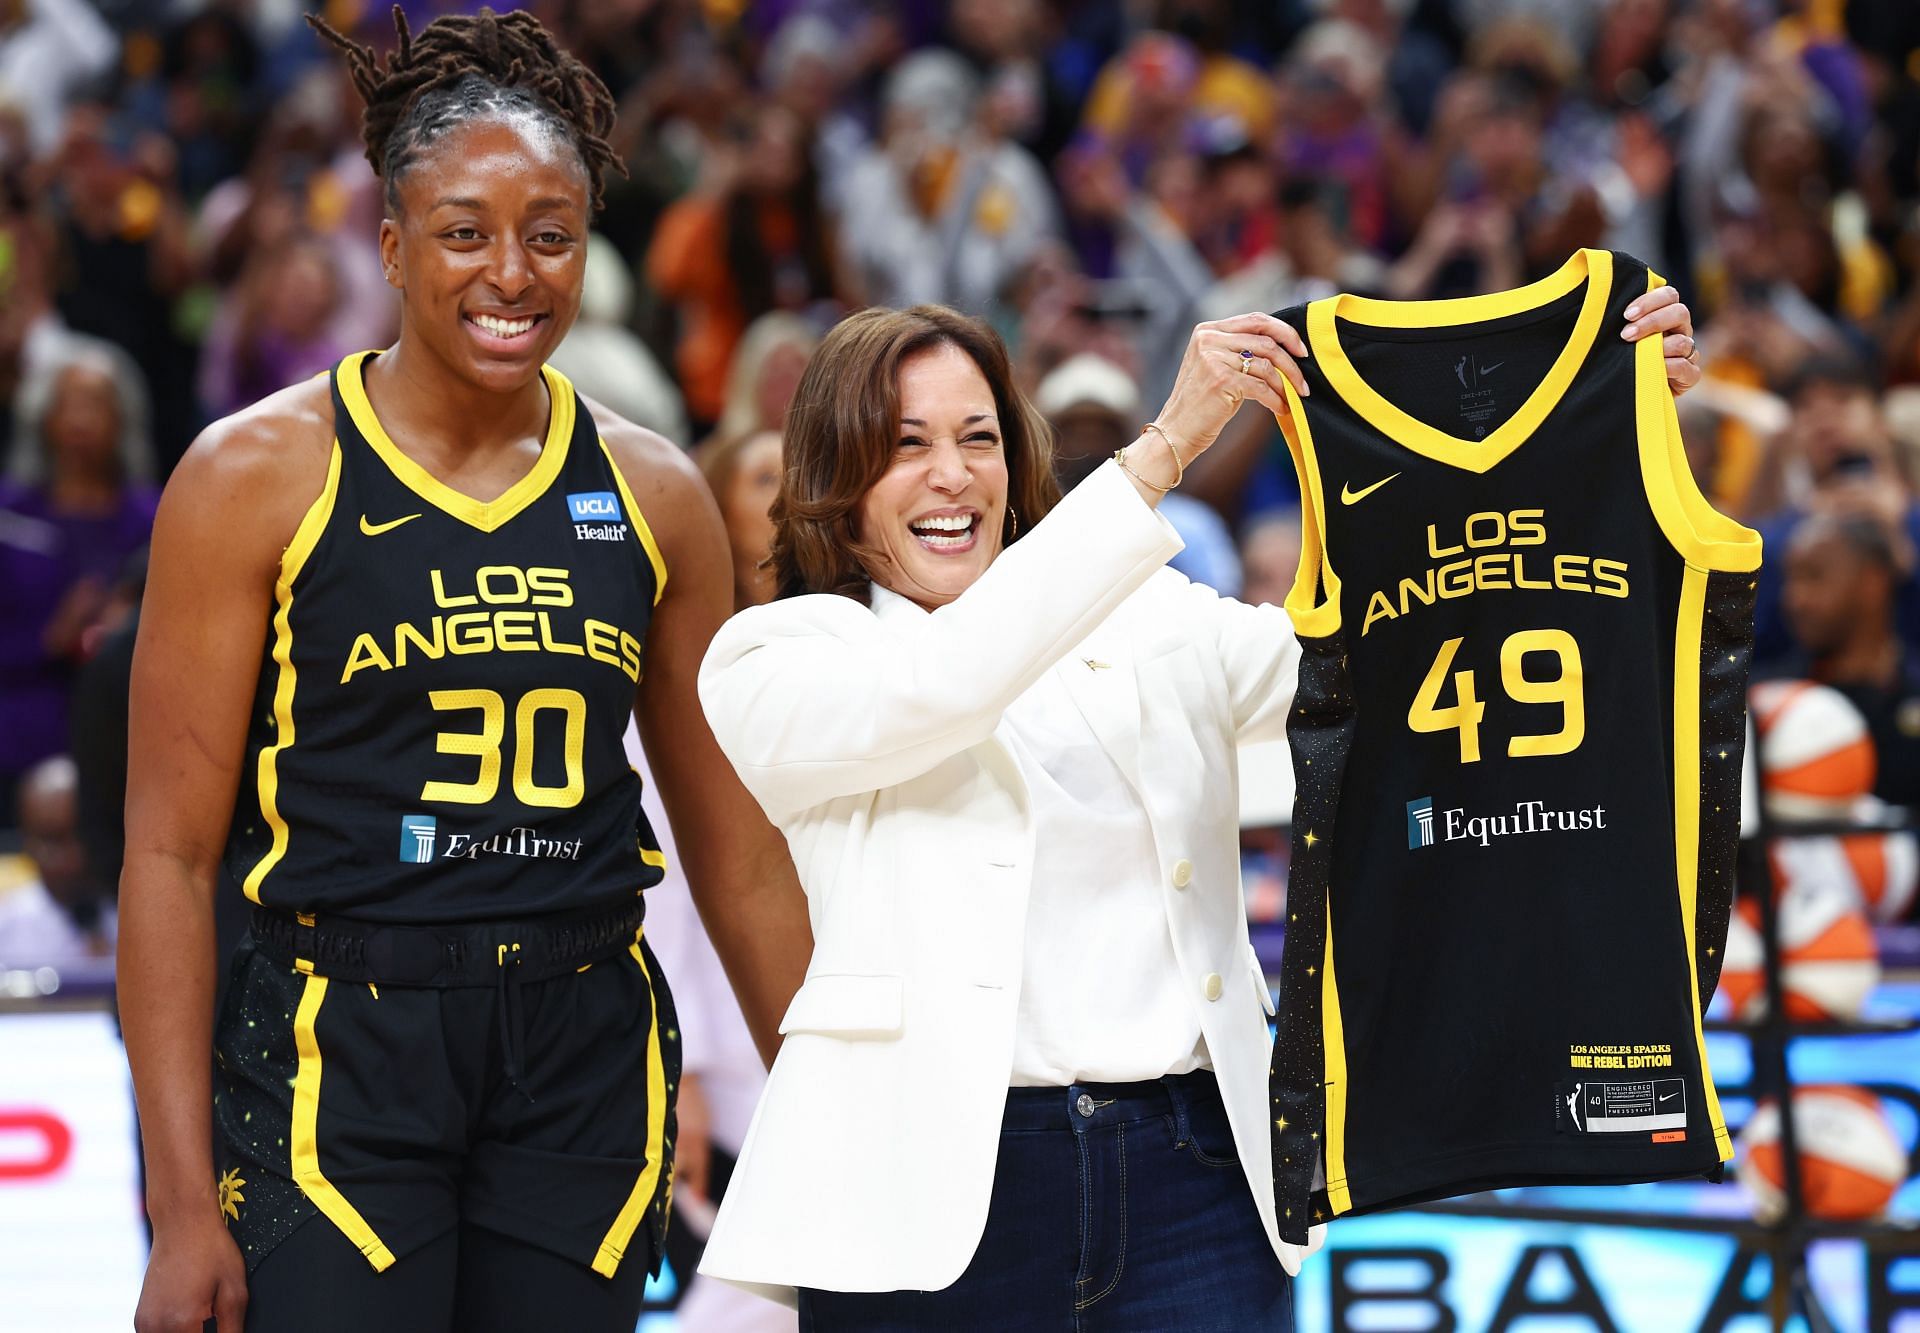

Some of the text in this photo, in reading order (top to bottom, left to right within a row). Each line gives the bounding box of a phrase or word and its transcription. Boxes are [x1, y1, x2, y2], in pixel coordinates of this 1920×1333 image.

[575, 499, 616, 515] UCLA
[1427, 509, 1547, 559] LOS
[430, 565, 574, 608] LOS
[1361, 553, 1630, 637] ANGELES
[340, 611, 641, 684] ANGELES
[1407, 628, 1586, 764] 49
[420, 688, 587, 809] 30
[1443, 800, 1607, 847] EquiTrust
[1570, 1044, 1671, 1054] LOS ANGELES SPARKS
[1570, 1054, 1672, 1069] NIKE REBEL EDITION
[1590, 1096, 1601, 1105] 40
[1606, 1084, 1651, 1092] ENGINEERED
